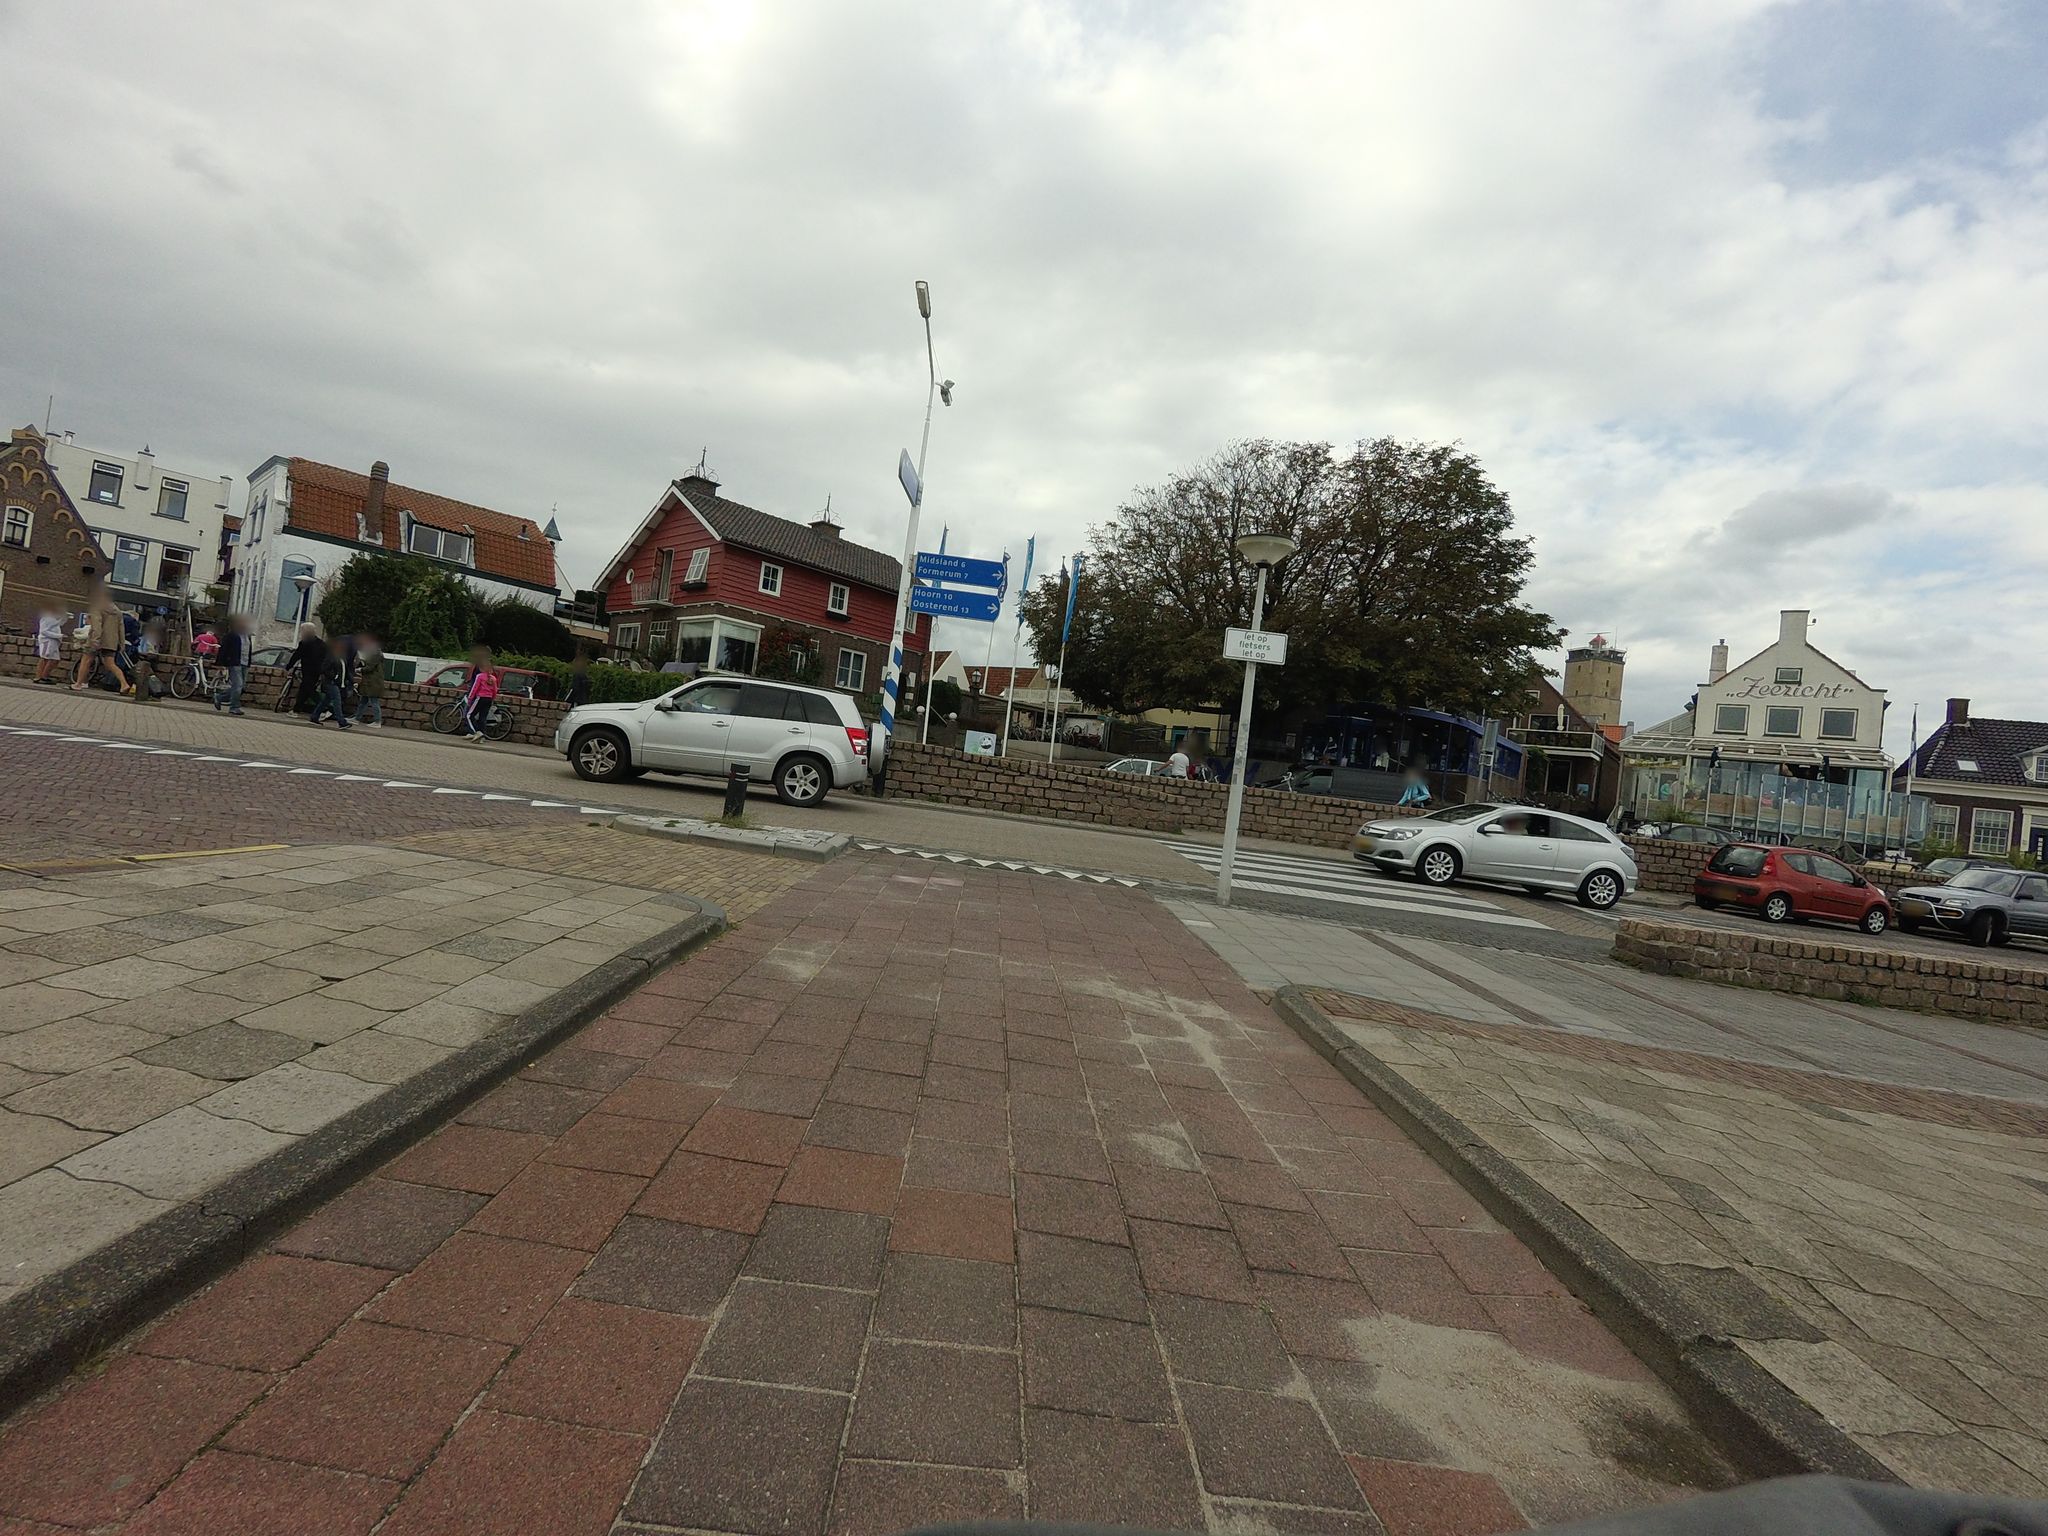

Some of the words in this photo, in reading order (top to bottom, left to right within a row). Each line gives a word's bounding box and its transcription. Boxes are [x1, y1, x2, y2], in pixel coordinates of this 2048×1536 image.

[919, 555, 959, 567] Midsland
[918, 566, 962, 579] Formerum
[914, 588, 941, 598] Hoorn
[913, 600, 958, 612] Oosterend
[960, 606, 969, 614] 13
[1244, 632, 1255, 640] let
[1239, 640, 1271, 650] fietsers
[1242, 649, 1253, 657] let
